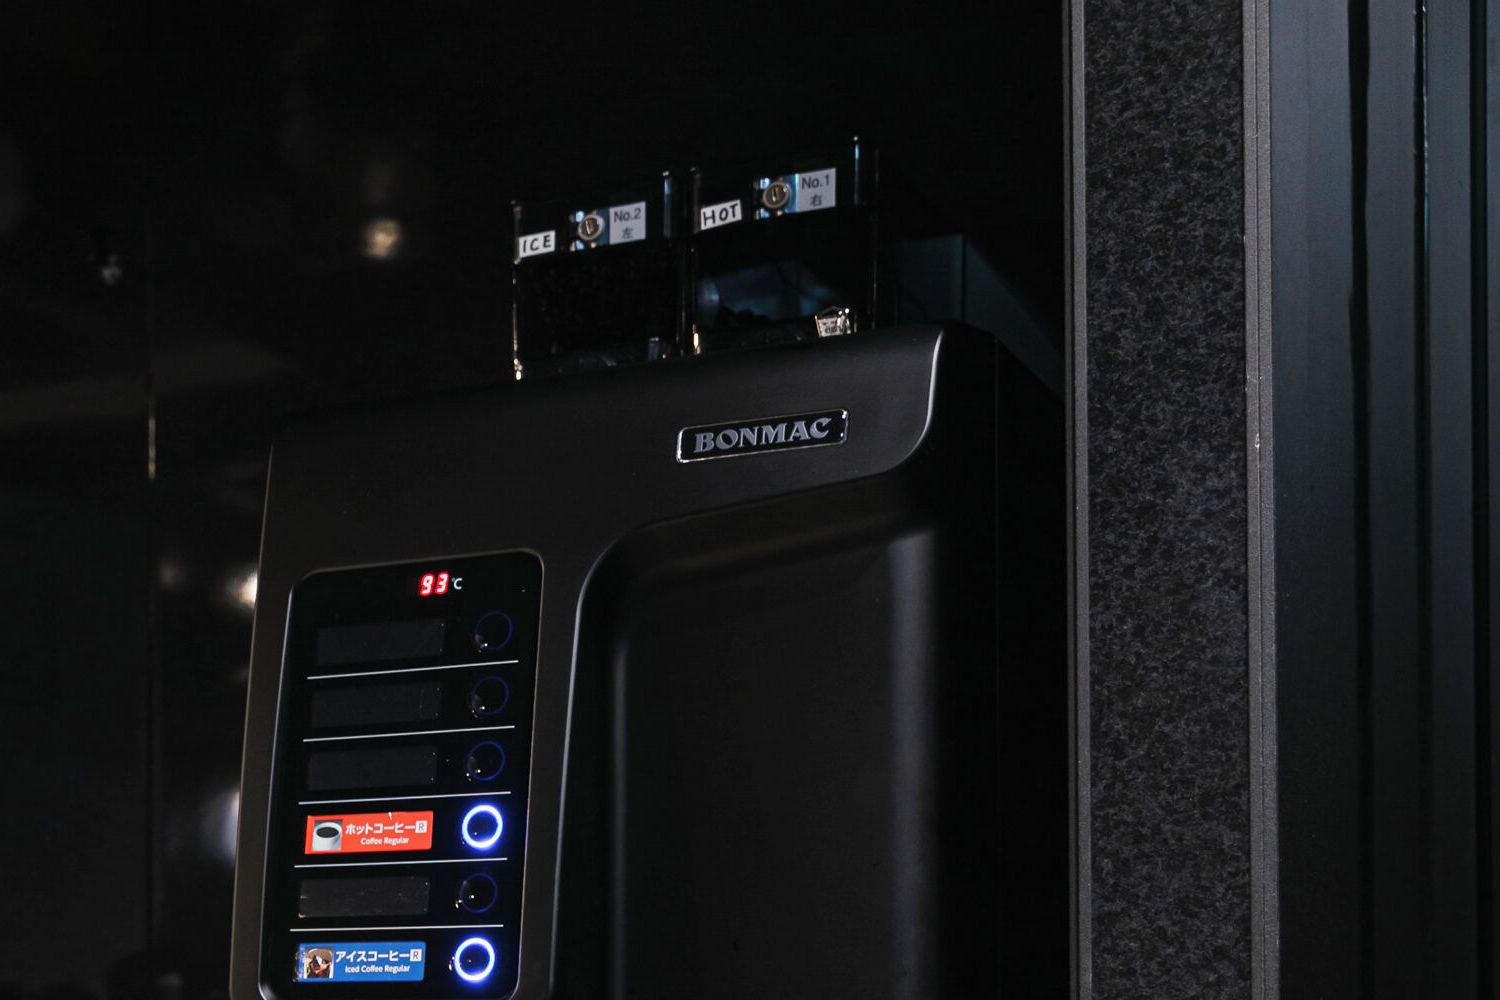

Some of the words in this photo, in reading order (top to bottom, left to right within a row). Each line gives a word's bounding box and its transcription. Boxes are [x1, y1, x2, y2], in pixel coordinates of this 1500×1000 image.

[801, 174, 830, 190] No.1
[810, 194, 822, 207] 右
[614, 207, 641, 223] No.2
[703, 203, 738, 227] HOT
[621, 227, 633, 239] 左
[523, 235, 551, 253] ICE
[693, 417, 832, 453] BONMAC
[360, 837, 382, 845] Coffee
[384, 836, 409, 846] Regular
[344, 965, 359, 973] Iced
[384, 964, 411, 974] Regular
